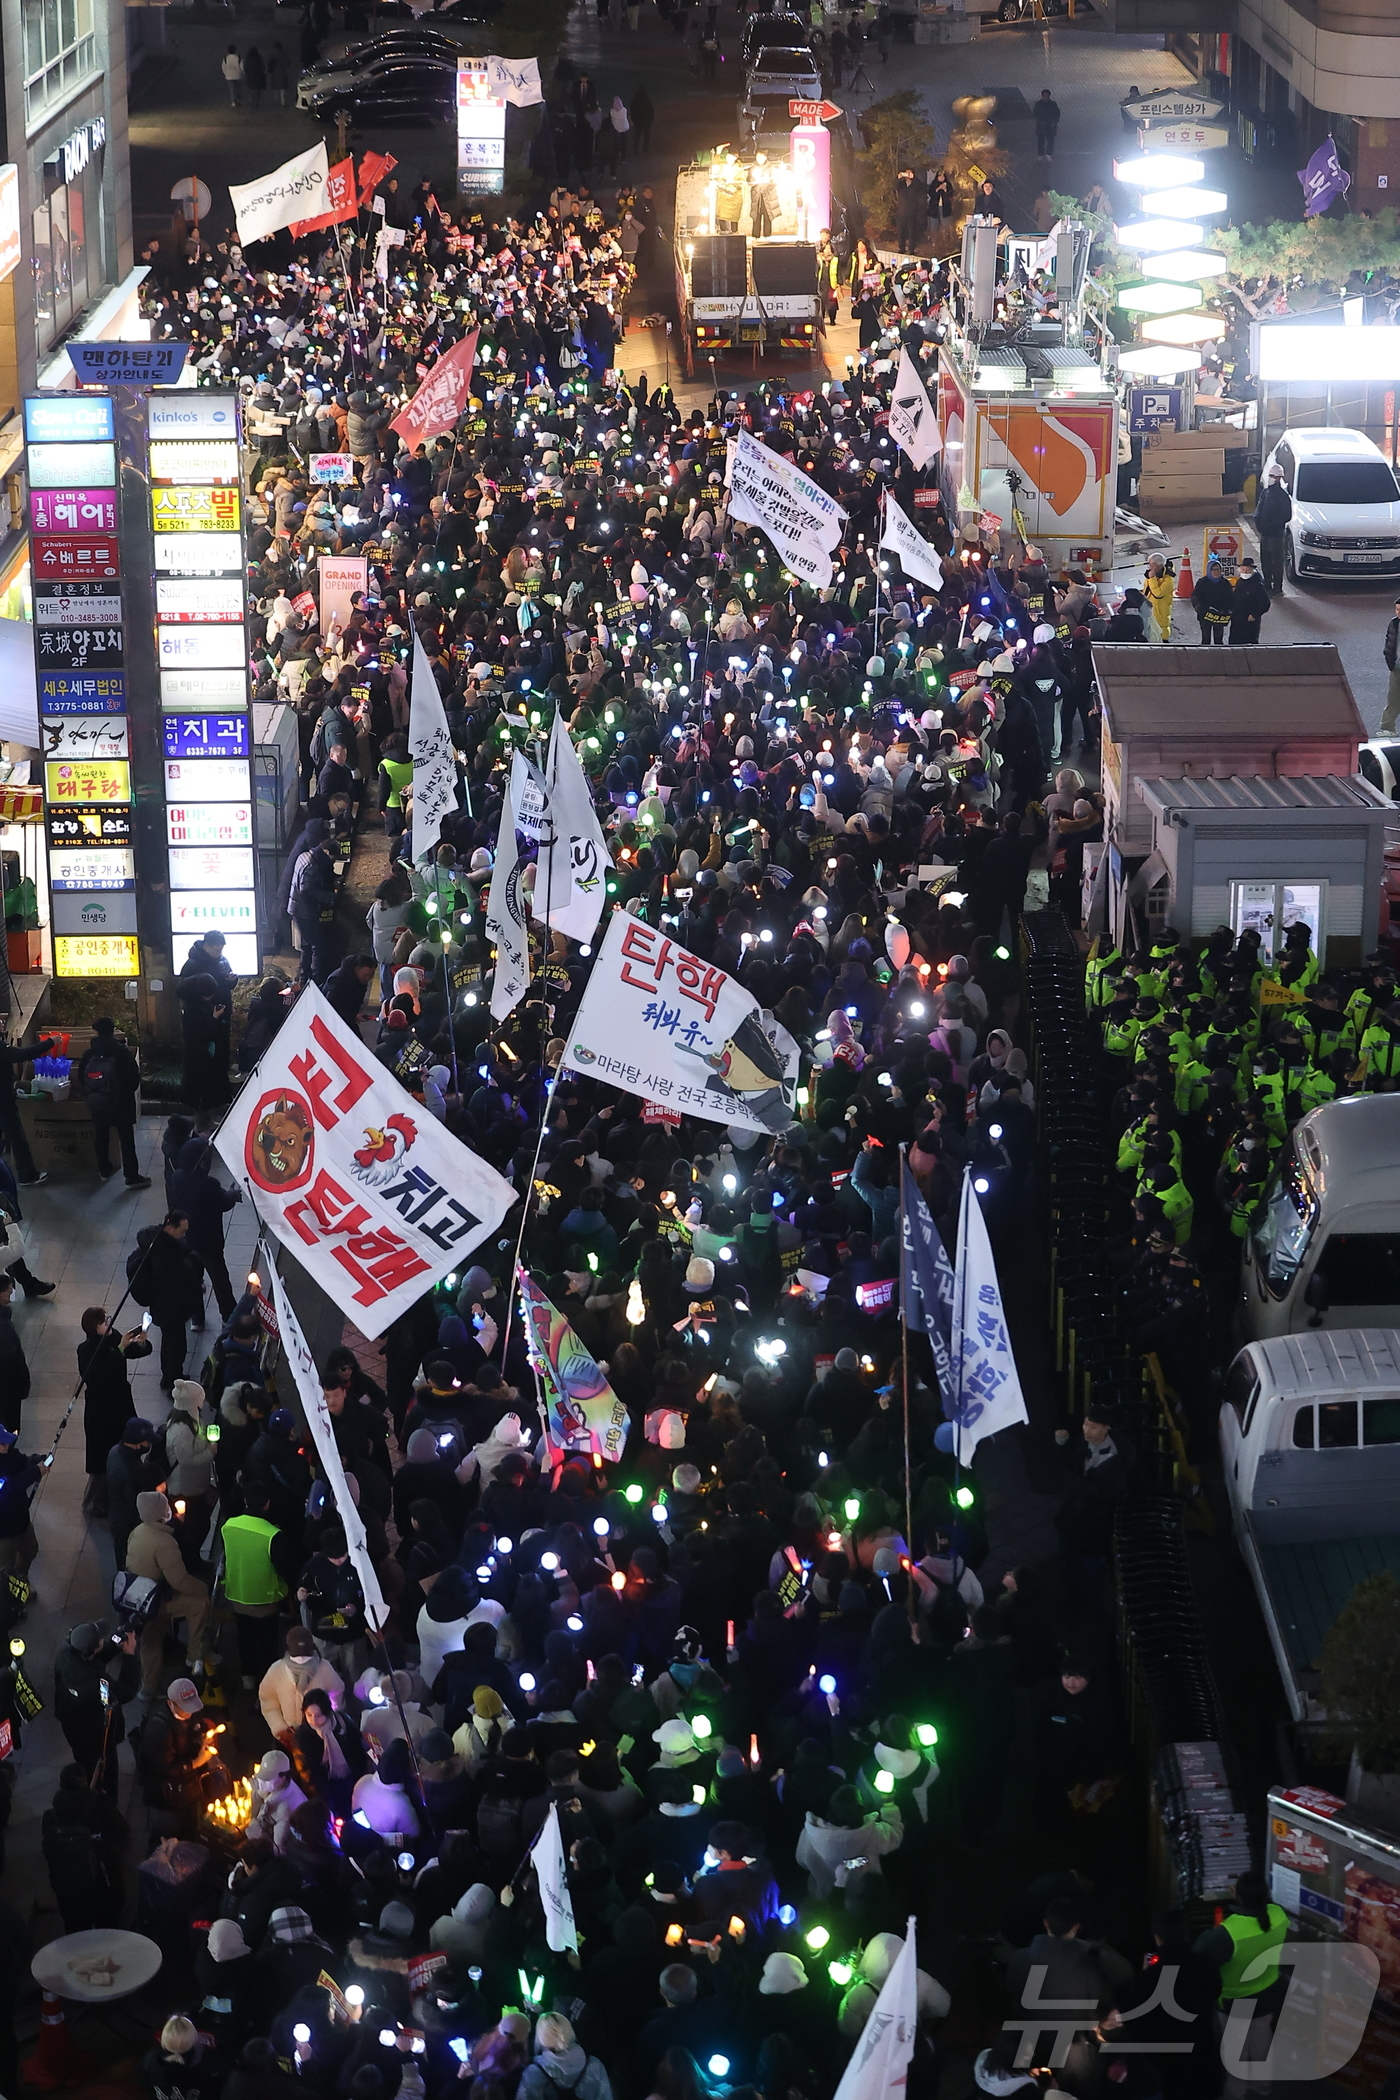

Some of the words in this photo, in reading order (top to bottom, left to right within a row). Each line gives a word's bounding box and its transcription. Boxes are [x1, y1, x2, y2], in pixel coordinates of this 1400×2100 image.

[793, 103, 824, 116] MADE
[1140, 103, 1206, 115] 프린스텔상가
[802, 116, 813, 126] B1
[92, 116, 106, 151] BAR
[1165, 131, 1205, 143] 연호두
[460, 173, 503, 183] SUBWAY
[96, 370, 163, 380] 상가안내도
[1145, 397, 1157, 414] P
[153, 408, 198, 423] kinko's
[33, 464, 80, 483] Coffee
[82, 459, 112, 484] 나무
[54, 492, 88, 503] 신미옥
[54, 503, 104, 528] 헤어
[199, 520, 235, 529] 783-8233
[42, 550, 110, 565] 슈베르트
[325, 570, 362, 580] GRAND
[52, 584, 105, 596] 결혼정보
[325, 580, 363, 590] OPENING
[61, 613, 119, 623] 010-3485-3008
[71, 656, 88, 667] 2F
[43, 679, 123, 696] 세우세무법인
[47, 702, 104, 711] T.3775-0881
[106, 699, 121, 711] 3F
[183, 719, 245, 744] 치과
[232, 746, 243, 755] 3F
[56, 779, 121, 799] 대구탕
[201, 852, 222, 874] 꽃
[60, 865, 127, 877] 공인중개사
[77, 880, 125, 888] 785-8949
[81, 913, 107, 923] 민생당
[74, 940, 136, 956] 공인중개사
[620, 922, 728, 1023] 탄핵
[597, 1053, 642, 1085] 마라탕
[643, 1073, 675, 1098] 사랑
[676, 1084, 708, 1108] 전국
[379, 1165, 483, 1251] 치고
[283, 1168, 433, 1308] 탄핵
[1275, 1823, 1284, 1834] 5
